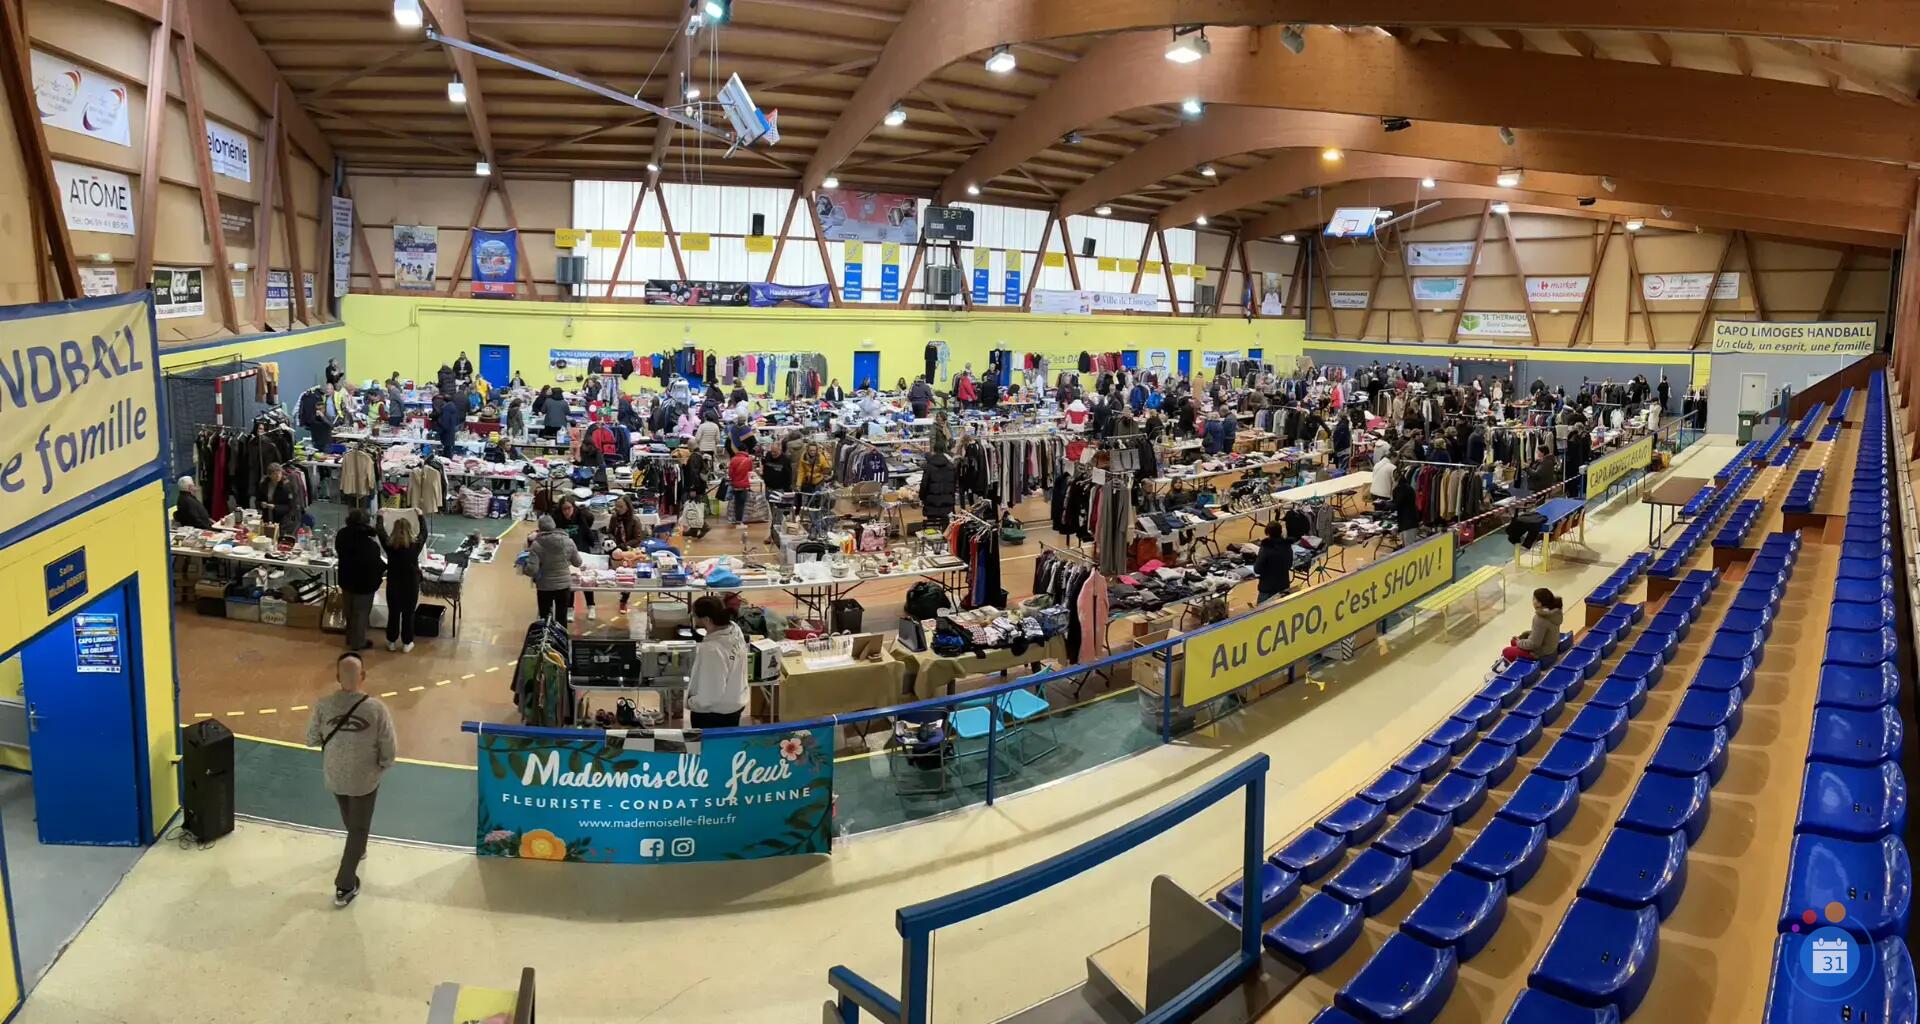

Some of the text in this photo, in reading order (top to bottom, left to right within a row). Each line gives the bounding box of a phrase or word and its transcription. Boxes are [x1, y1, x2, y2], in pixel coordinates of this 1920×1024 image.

[769, 287, 810, 297] Haute-Vienne
[1551, 280, 1577, 289] market
[1102, 295, 1118, 305] Ville
[1717, 325, 1872, 338] CAPO LIMOGES HANDBALL
[1716, 339, 1730, 349] Un
[1732, 340, 1755, 351] club,
[1775, 342, 1807, 353] esprit,
[1832, 341, 1871, 353] famille
[35, 397, 147, 494] famille
[1210, 546, 1442, 679] Au CAPO, c'est SHOW !
[521, 749, 792, 801] Mademoiselle fleur
[502, 793, 602, 810] FLEURISTE
[620, 797, 697, 810] CONDAT
[704, 795, 739, 808] SUR
[744, 787, 812, 805] VIENNE
[578, 813, 737, 829] www.mademoiselle-fleur.fr
